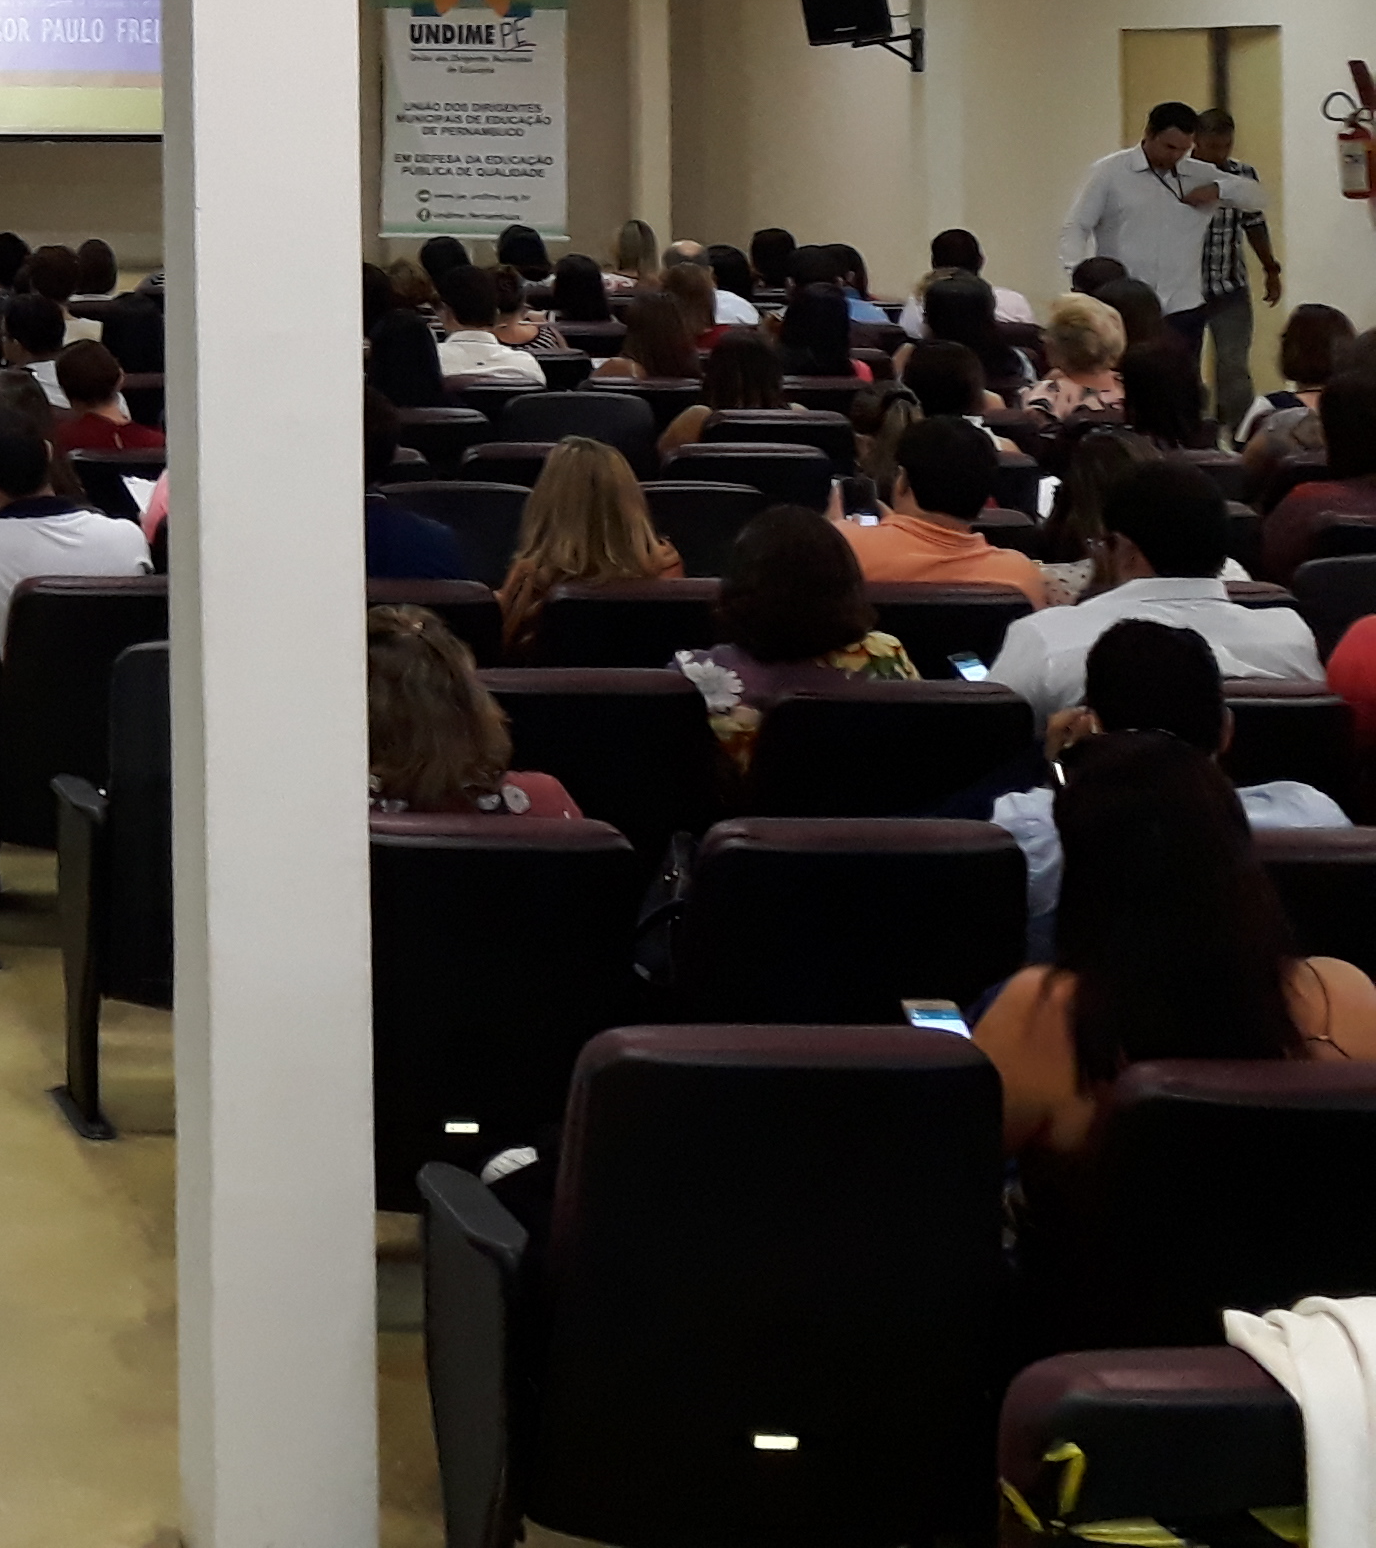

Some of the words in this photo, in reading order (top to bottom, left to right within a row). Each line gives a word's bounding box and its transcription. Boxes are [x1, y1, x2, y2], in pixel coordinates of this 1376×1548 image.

[41, 16, 105, 43] PAULO
[117, 16, 160, 44] FREI
[410, 23, 496, 45] UNDIME
